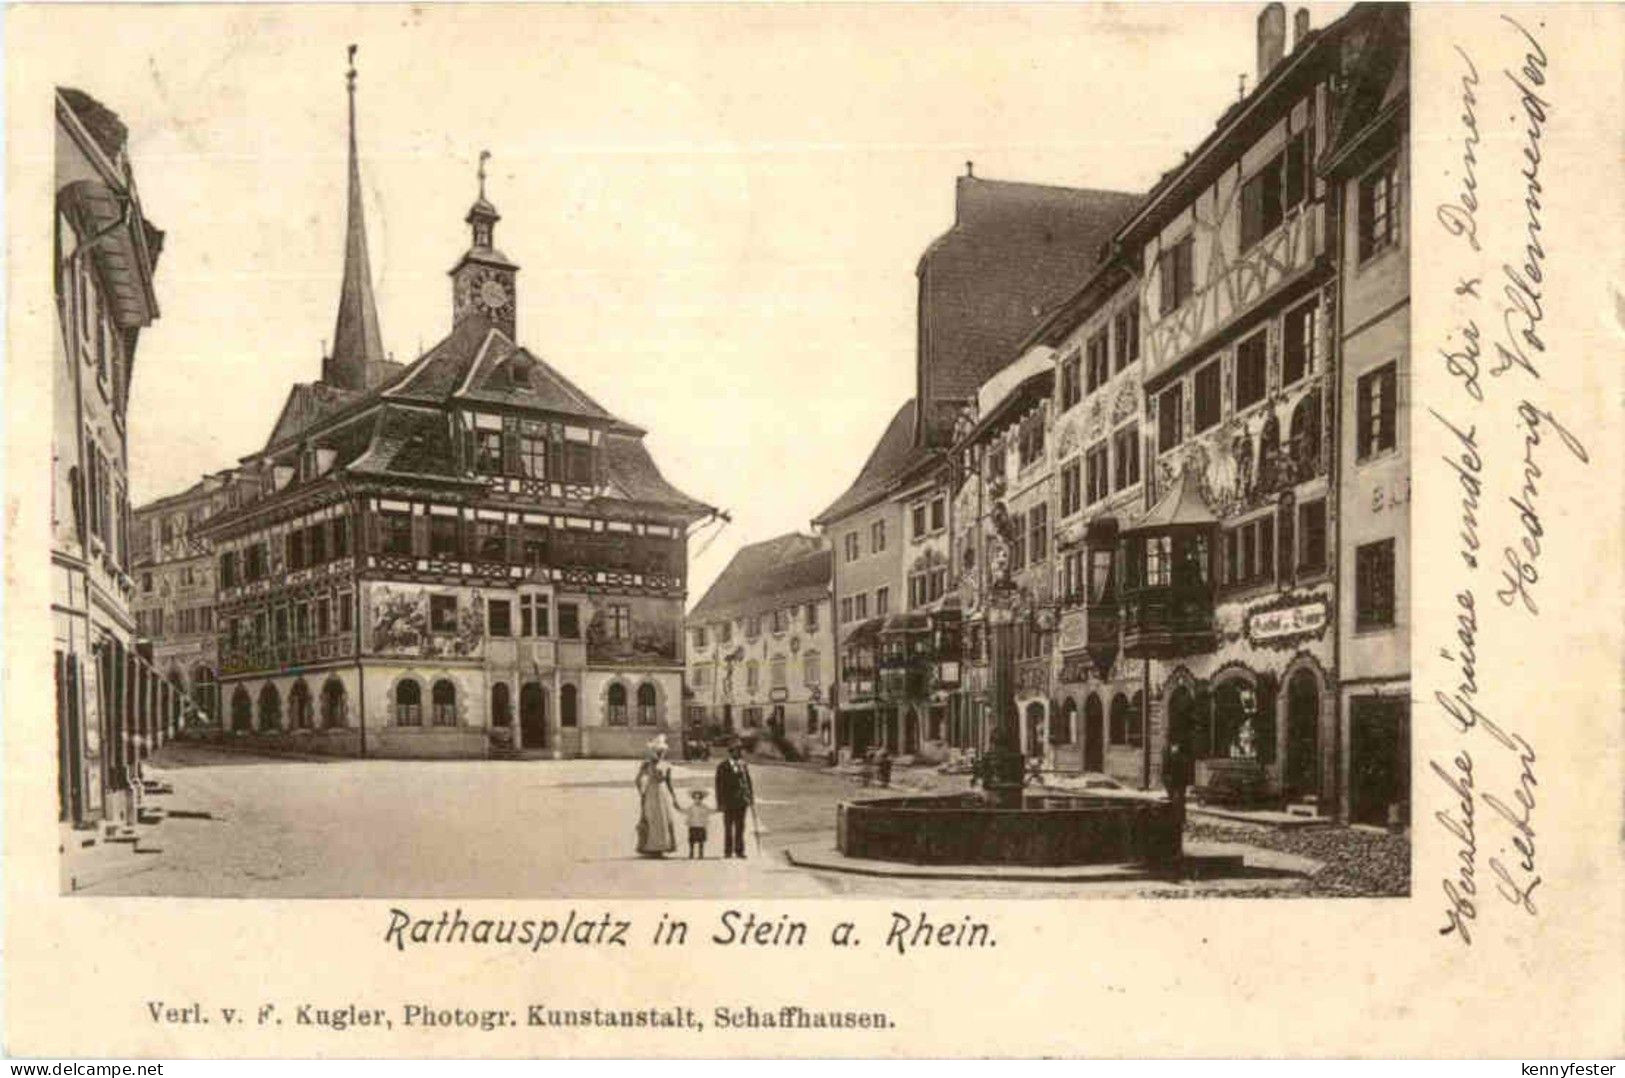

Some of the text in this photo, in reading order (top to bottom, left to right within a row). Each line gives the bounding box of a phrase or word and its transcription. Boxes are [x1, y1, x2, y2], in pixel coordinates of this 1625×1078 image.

[1439, 320, 1483, 401] Dir
[1428, 407, 1482, 569] sendet
[1497, 400, 1589, 616] Hedwig
[1434, 589, 1517, 751] Grüsse
[1430, 751, 1476, 945] Herzliche
[1481, 733, 1541, 915] Lieben
[384, 909, 997, 956] Rathausplatz in Stein a. Rhein.
[147, 1001, 896, 1033] Verl. v. F. Kugler, Photogr. Kunstanstalt, Schaffhausen.
